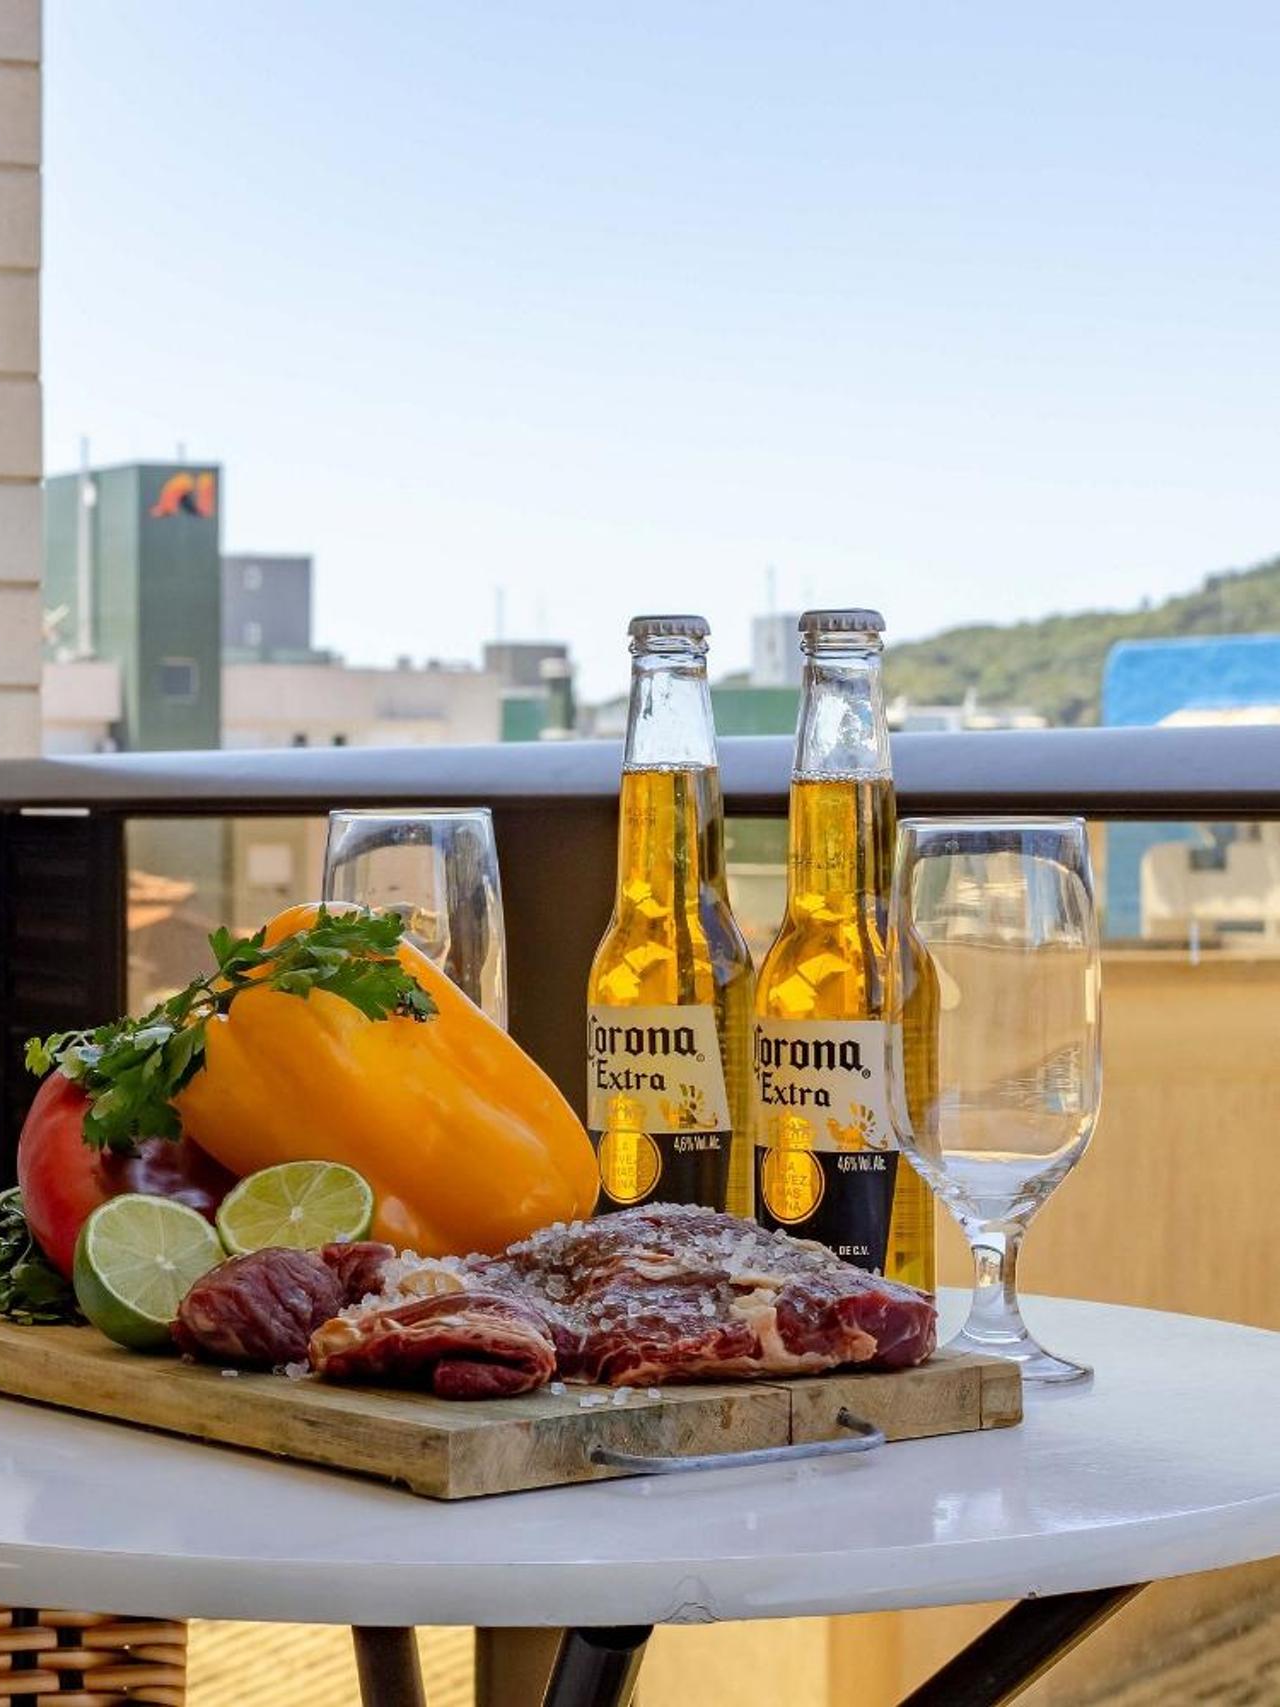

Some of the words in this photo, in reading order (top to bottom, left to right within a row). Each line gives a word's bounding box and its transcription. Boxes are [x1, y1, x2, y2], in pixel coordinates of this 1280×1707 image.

[596, 1058, 667, 1091] Extra
[761, 1071, 832, 1107] Extra
[838, 1245, 852, 1256] DE
